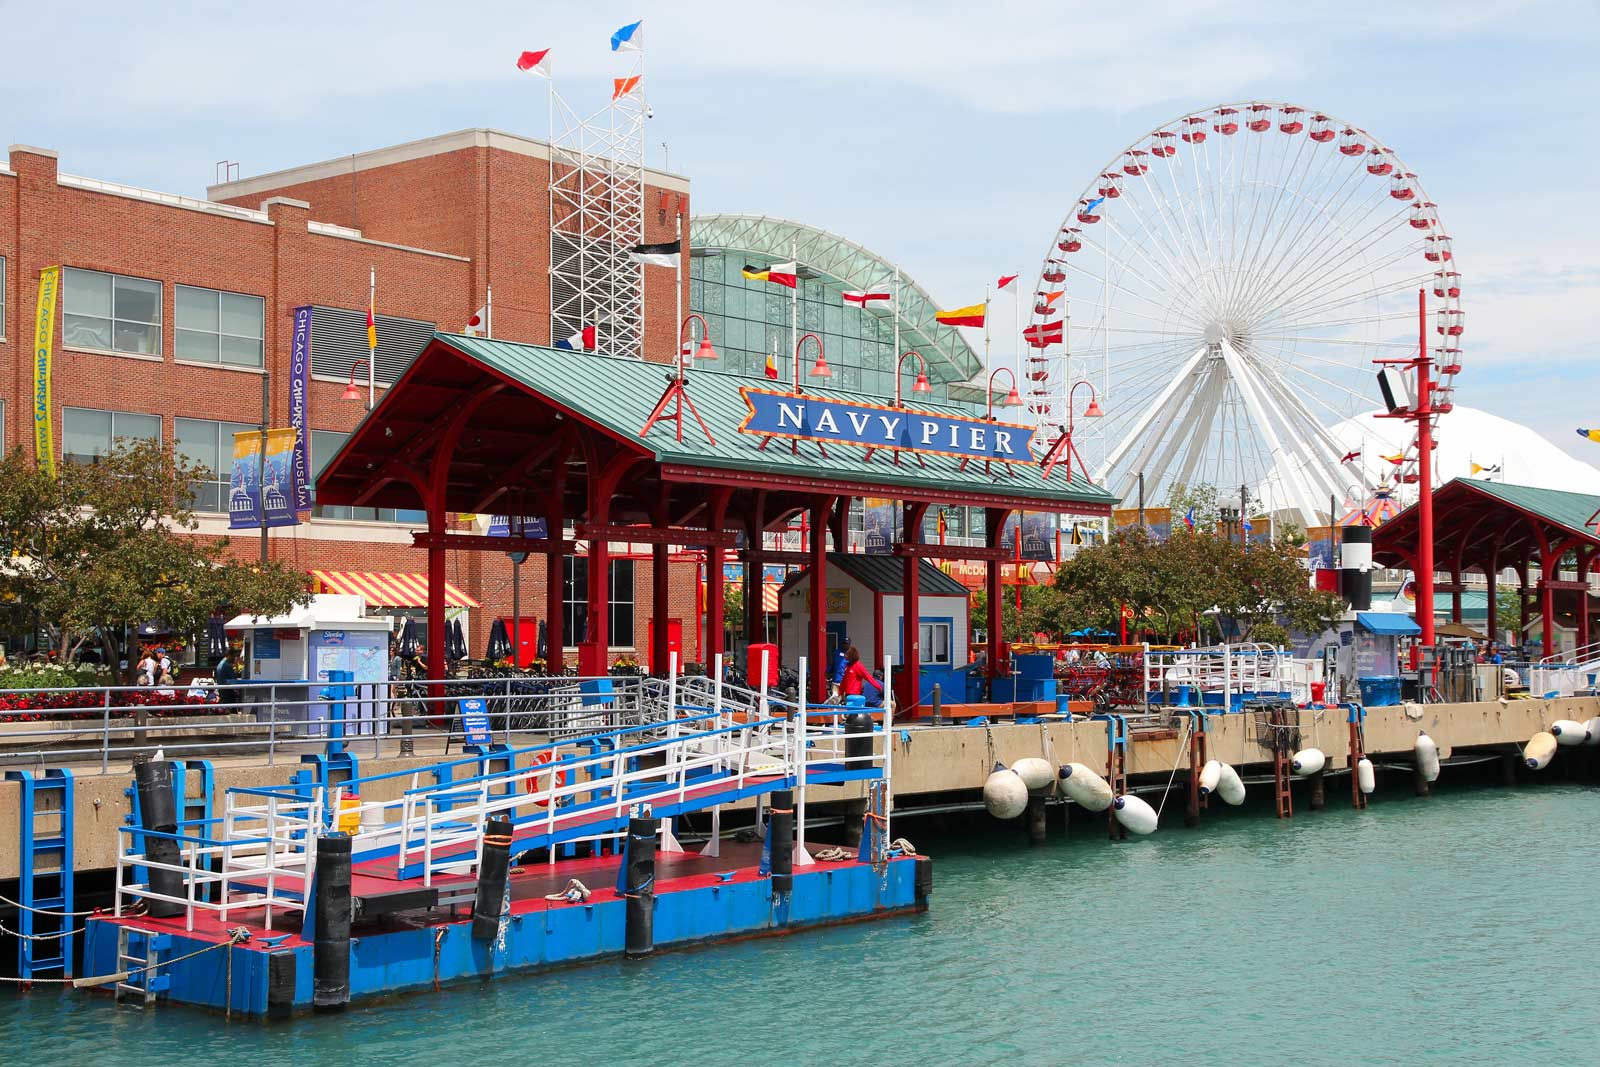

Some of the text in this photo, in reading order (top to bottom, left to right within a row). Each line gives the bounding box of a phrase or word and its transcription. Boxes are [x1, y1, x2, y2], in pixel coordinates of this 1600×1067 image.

[39, 271, 54, 344] CHICAGO
[294, 309, 308, 375] CHICAGO
[777, 402, 1014, 454] NAVY PIER
[295, 448, 307, 507] MUSEUM
[959, 564, 1011, 577] McDo's
